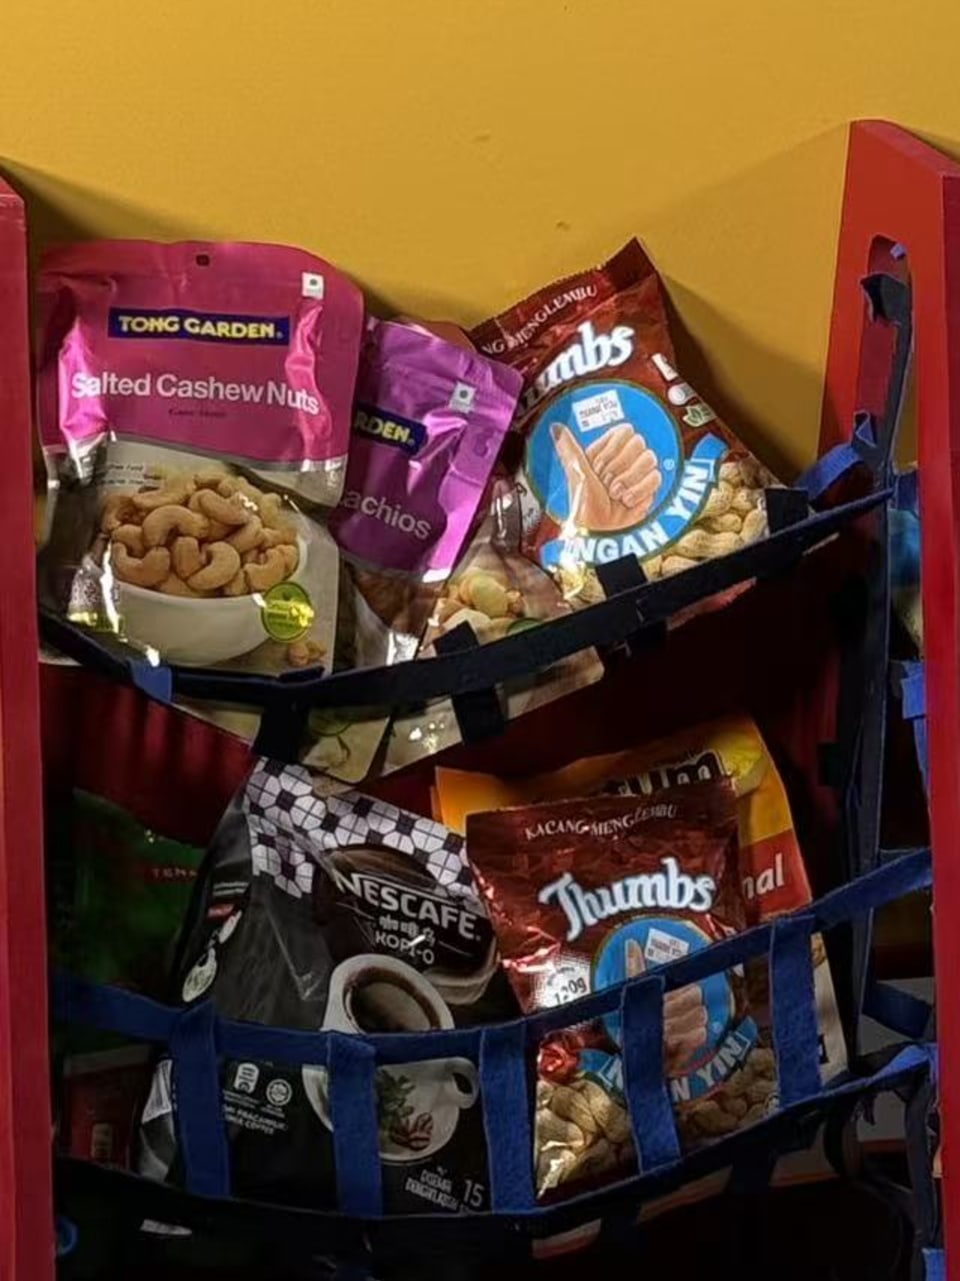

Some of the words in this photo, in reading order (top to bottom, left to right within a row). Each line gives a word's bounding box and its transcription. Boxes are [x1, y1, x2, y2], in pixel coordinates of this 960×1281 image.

[118, 315, 180, 333] TONG
[183, 319, 275, 339] GARDEN
[71, 371, 151, 399] Salted
[156, 373, 263, 403] Cashew
[266, 381, 320, 415] Nuts
[662, 460, 713, 522] YIN
[538, 856, 716, 942] Thumbs
[463, 1179, 485, 1207] 15
